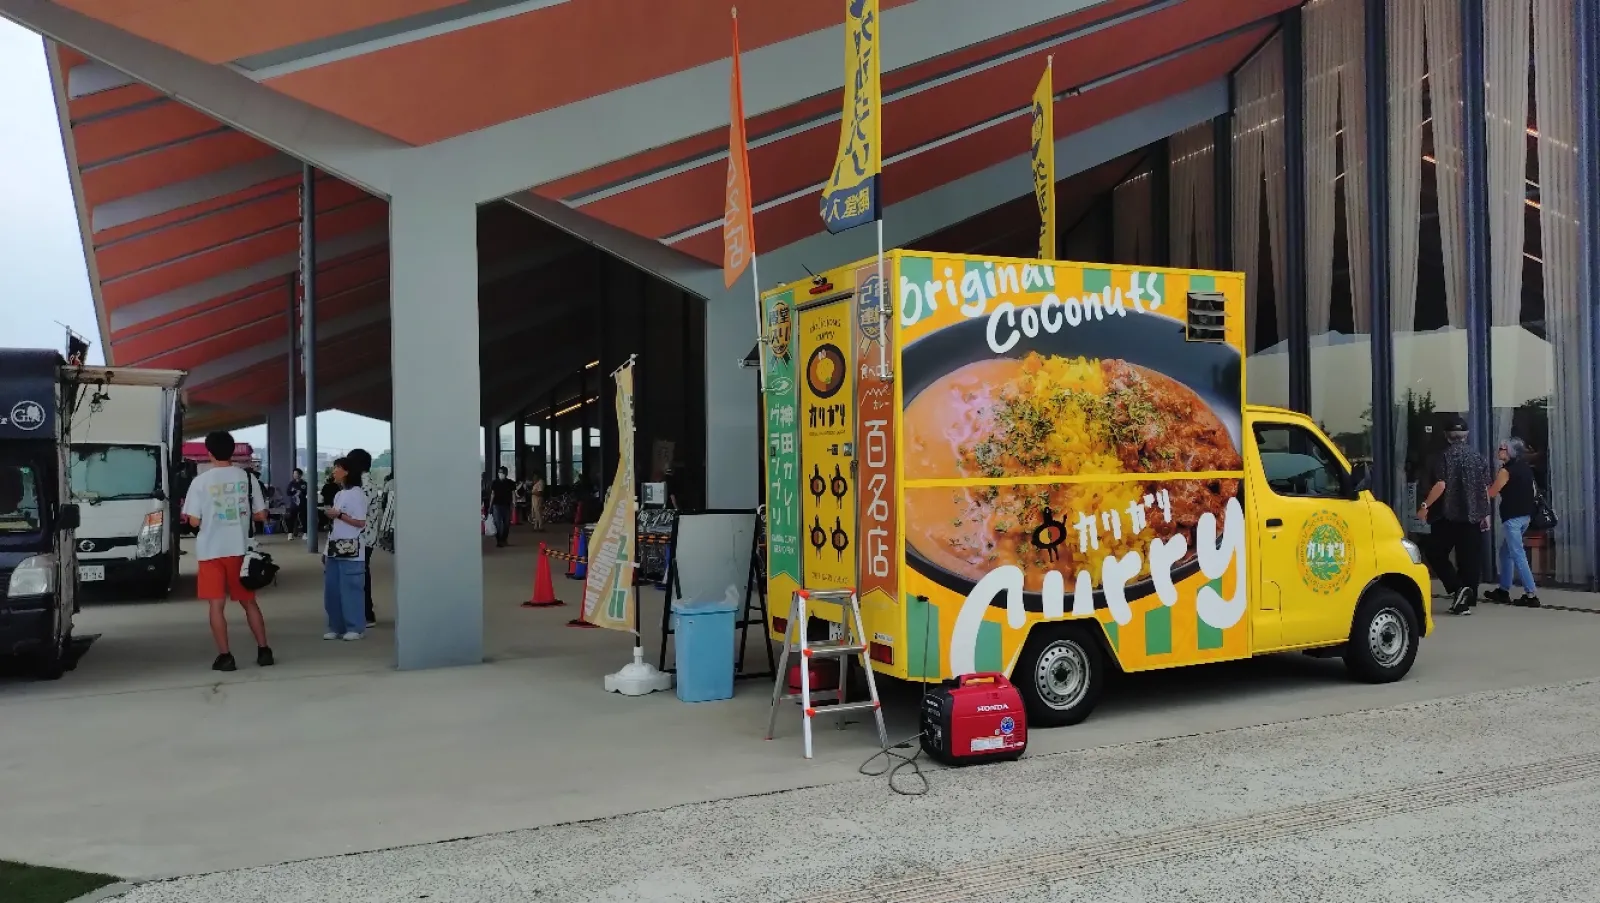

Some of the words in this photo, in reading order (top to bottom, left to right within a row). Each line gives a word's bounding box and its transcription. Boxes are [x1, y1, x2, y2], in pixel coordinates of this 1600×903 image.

[809, 403, 846, 429] カリガリ
[864, 419, 889, 577] 百名店
[1073, 488, 1172, 554] カリガリ
[976, 703, 1009, 712] HONDA
